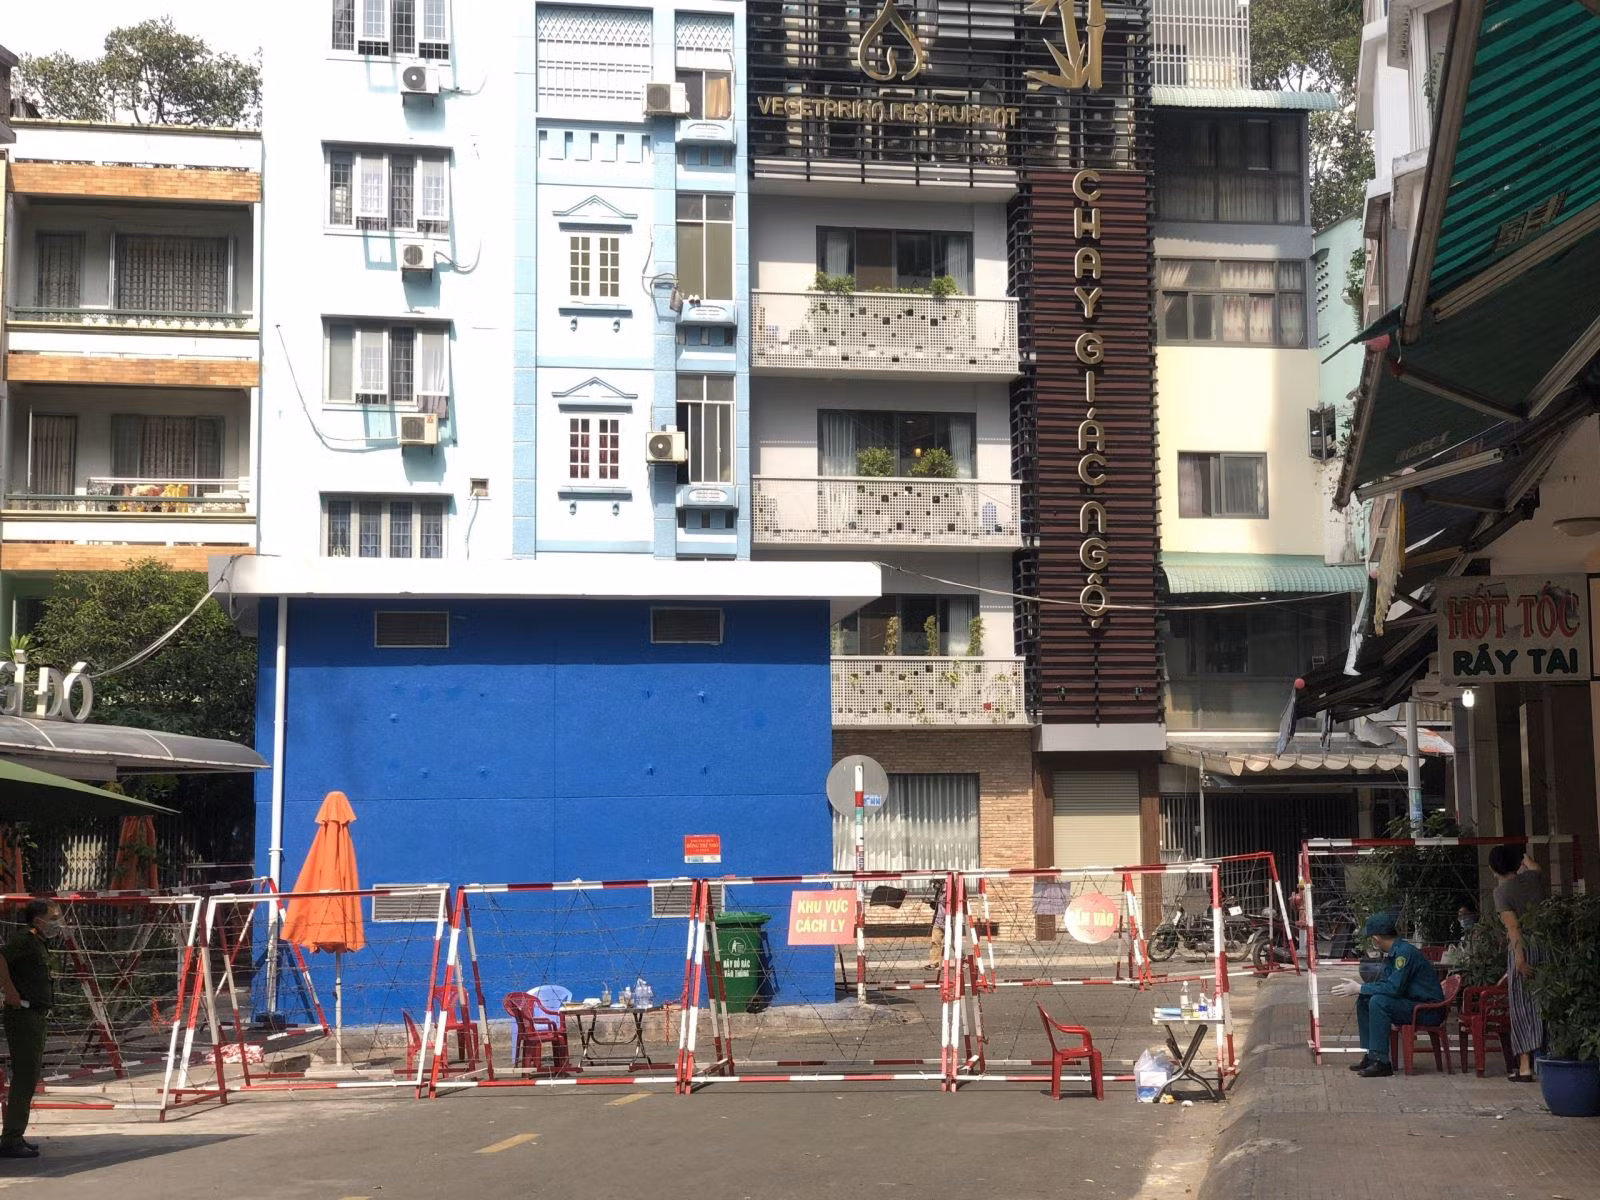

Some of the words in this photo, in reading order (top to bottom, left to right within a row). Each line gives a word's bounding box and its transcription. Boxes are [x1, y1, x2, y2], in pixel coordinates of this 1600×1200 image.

[758, 96, 885, 120] VEGETARIAN
[890, 102, 1020, 126] RESTAURANT
[1072, 169, 1102, 319] CHAY
[1074, 331, 1106, 486] GIÁC
[1453, 643, 1518, 676] RÁY
[1527, 648, 1578, 675] TAI
[797, 899, 822, 914] KHU
[825, 897, 849, 916] VỰC
[795, 916, 827, 933] CÁCH
[830, 918, 846, 933] LY
